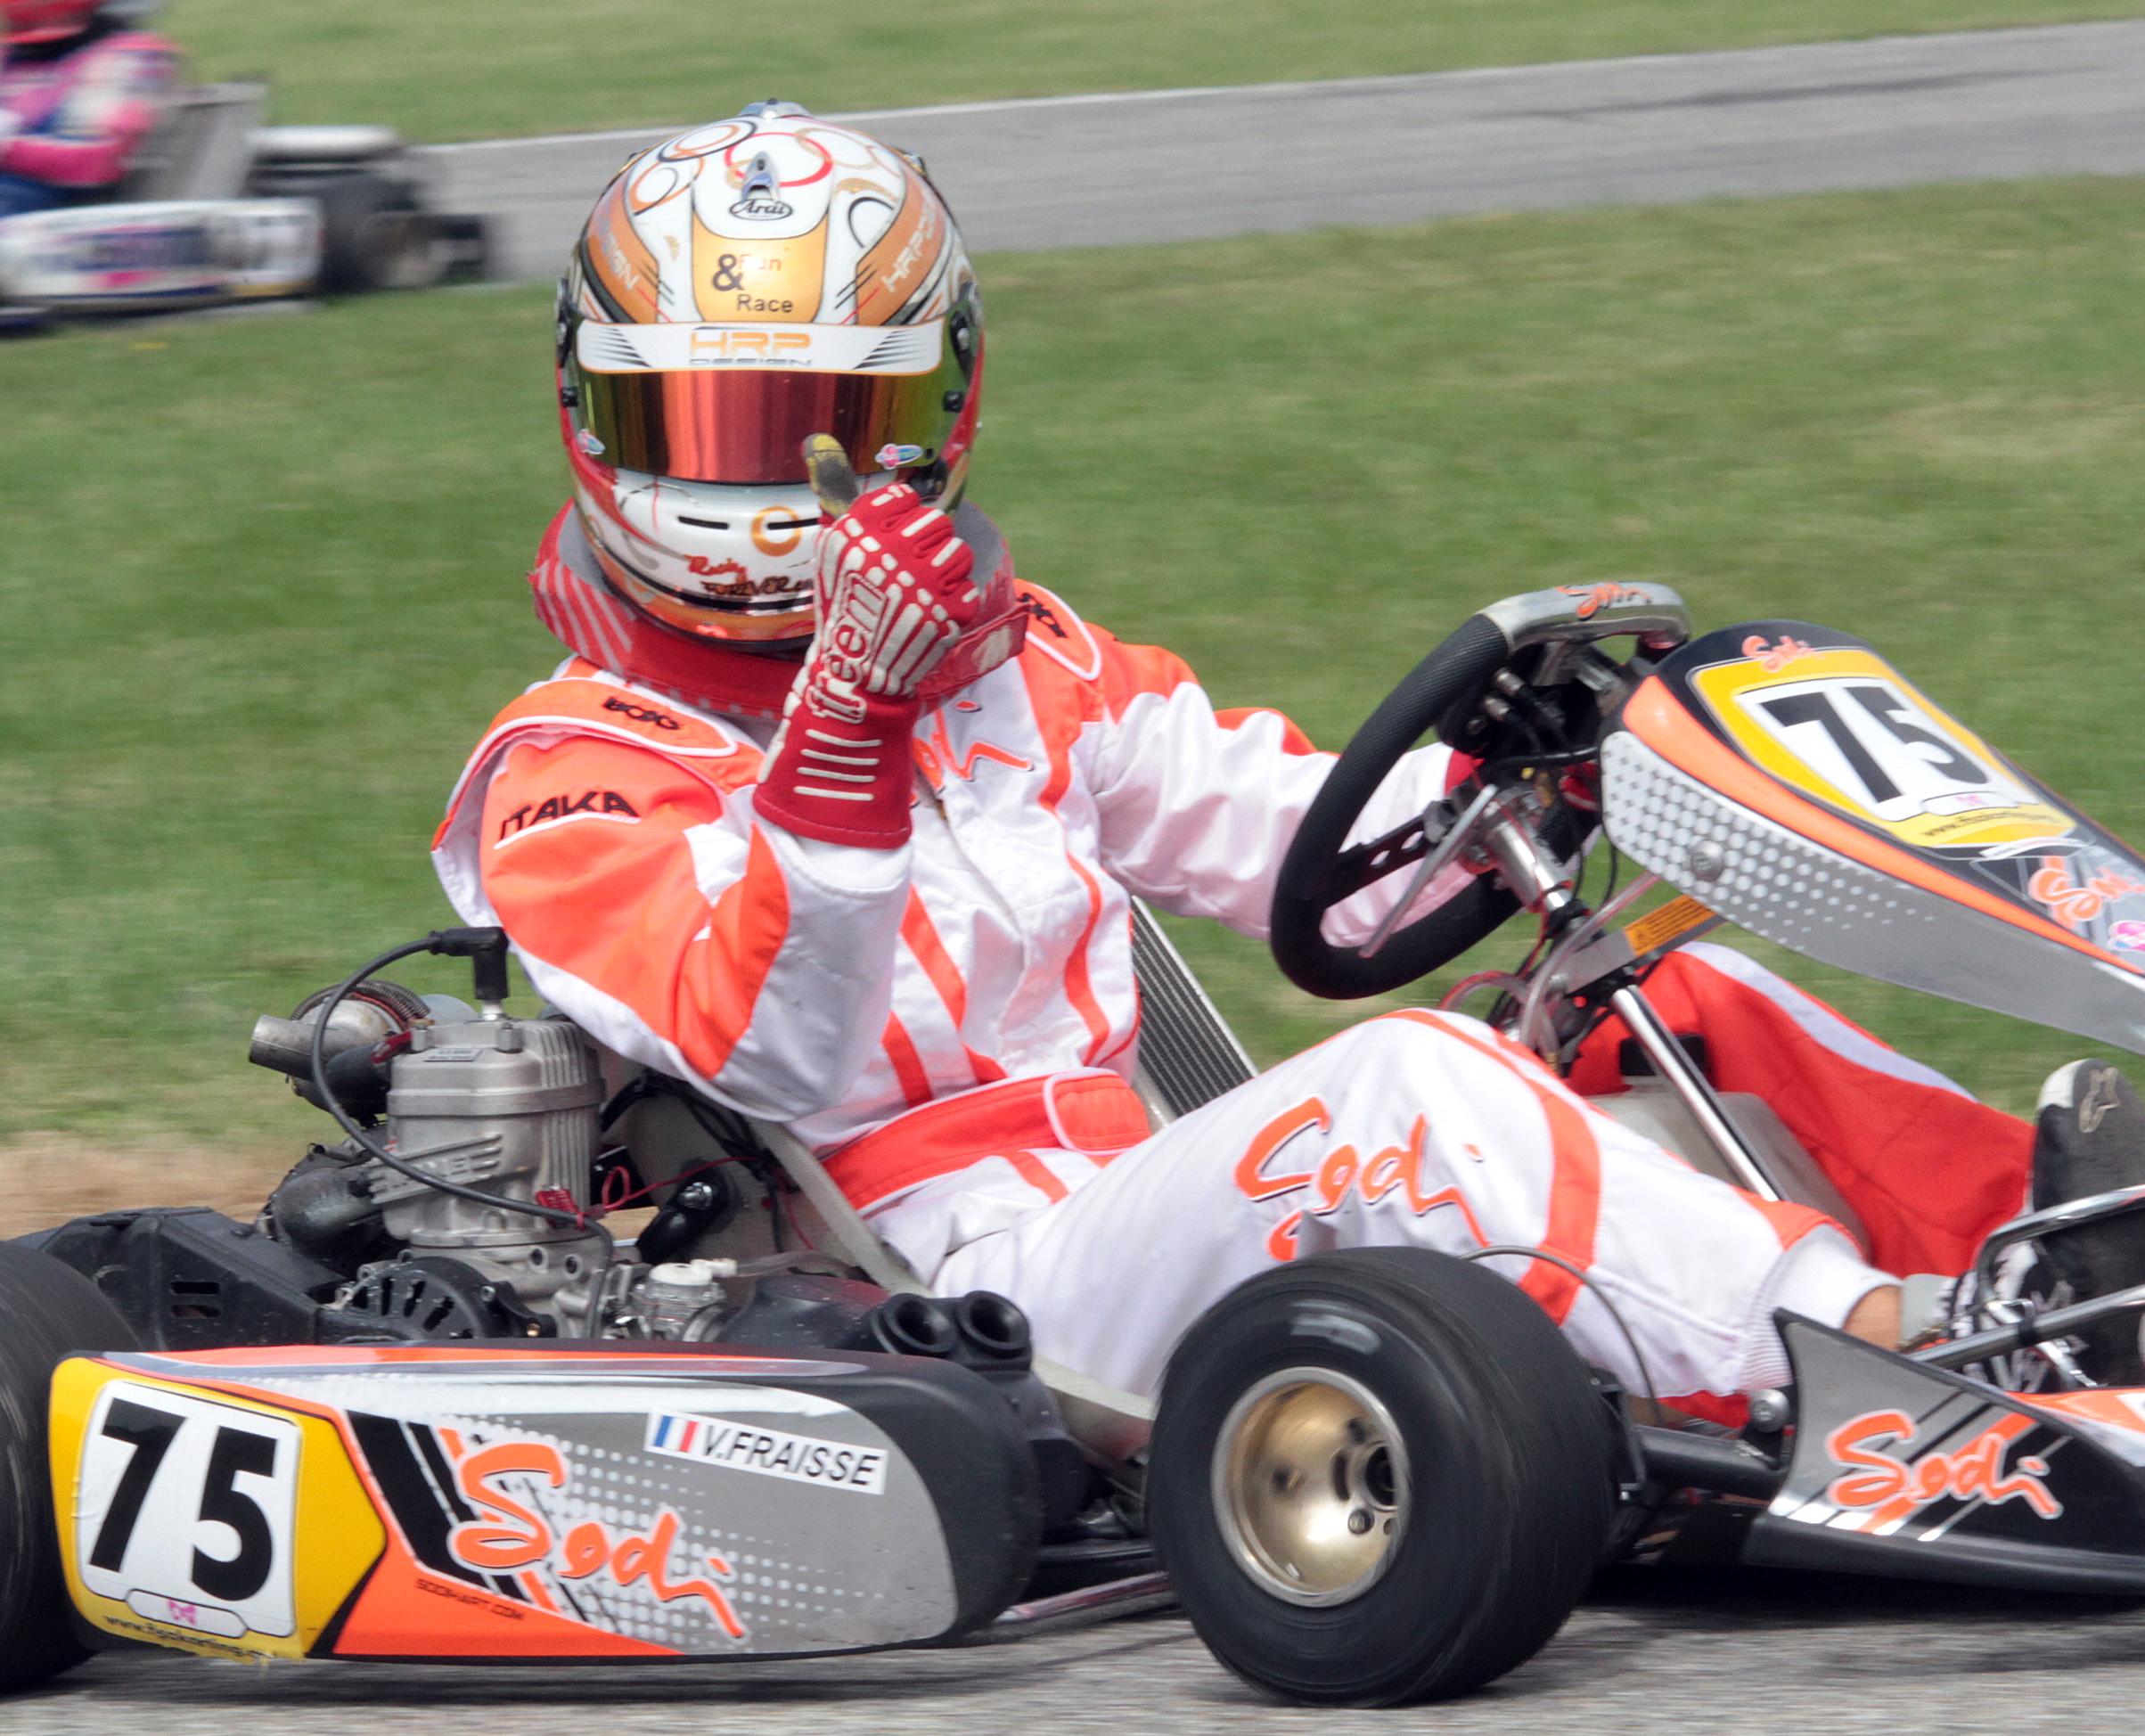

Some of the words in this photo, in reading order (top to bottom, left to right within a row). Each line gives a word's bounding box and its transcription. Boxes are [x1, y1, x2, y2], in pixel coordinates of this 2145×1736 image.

[731, 199, 788, 217] Arai
[711, 253, 744, 292] &
[736, 293, 794, 314] Race
[690, 332, 813, 357] HRP
[1759, 685, 1989, 803] 75
[499, 790, 641, 840] ITAKA
[703, 1425, 880, 1486] V.FRAISSE
[1827, 1410, 2065, 1518] Sodi
[87, 1396, 278, 1602] 75
[451, 1442, 747, 1639] Sodi
